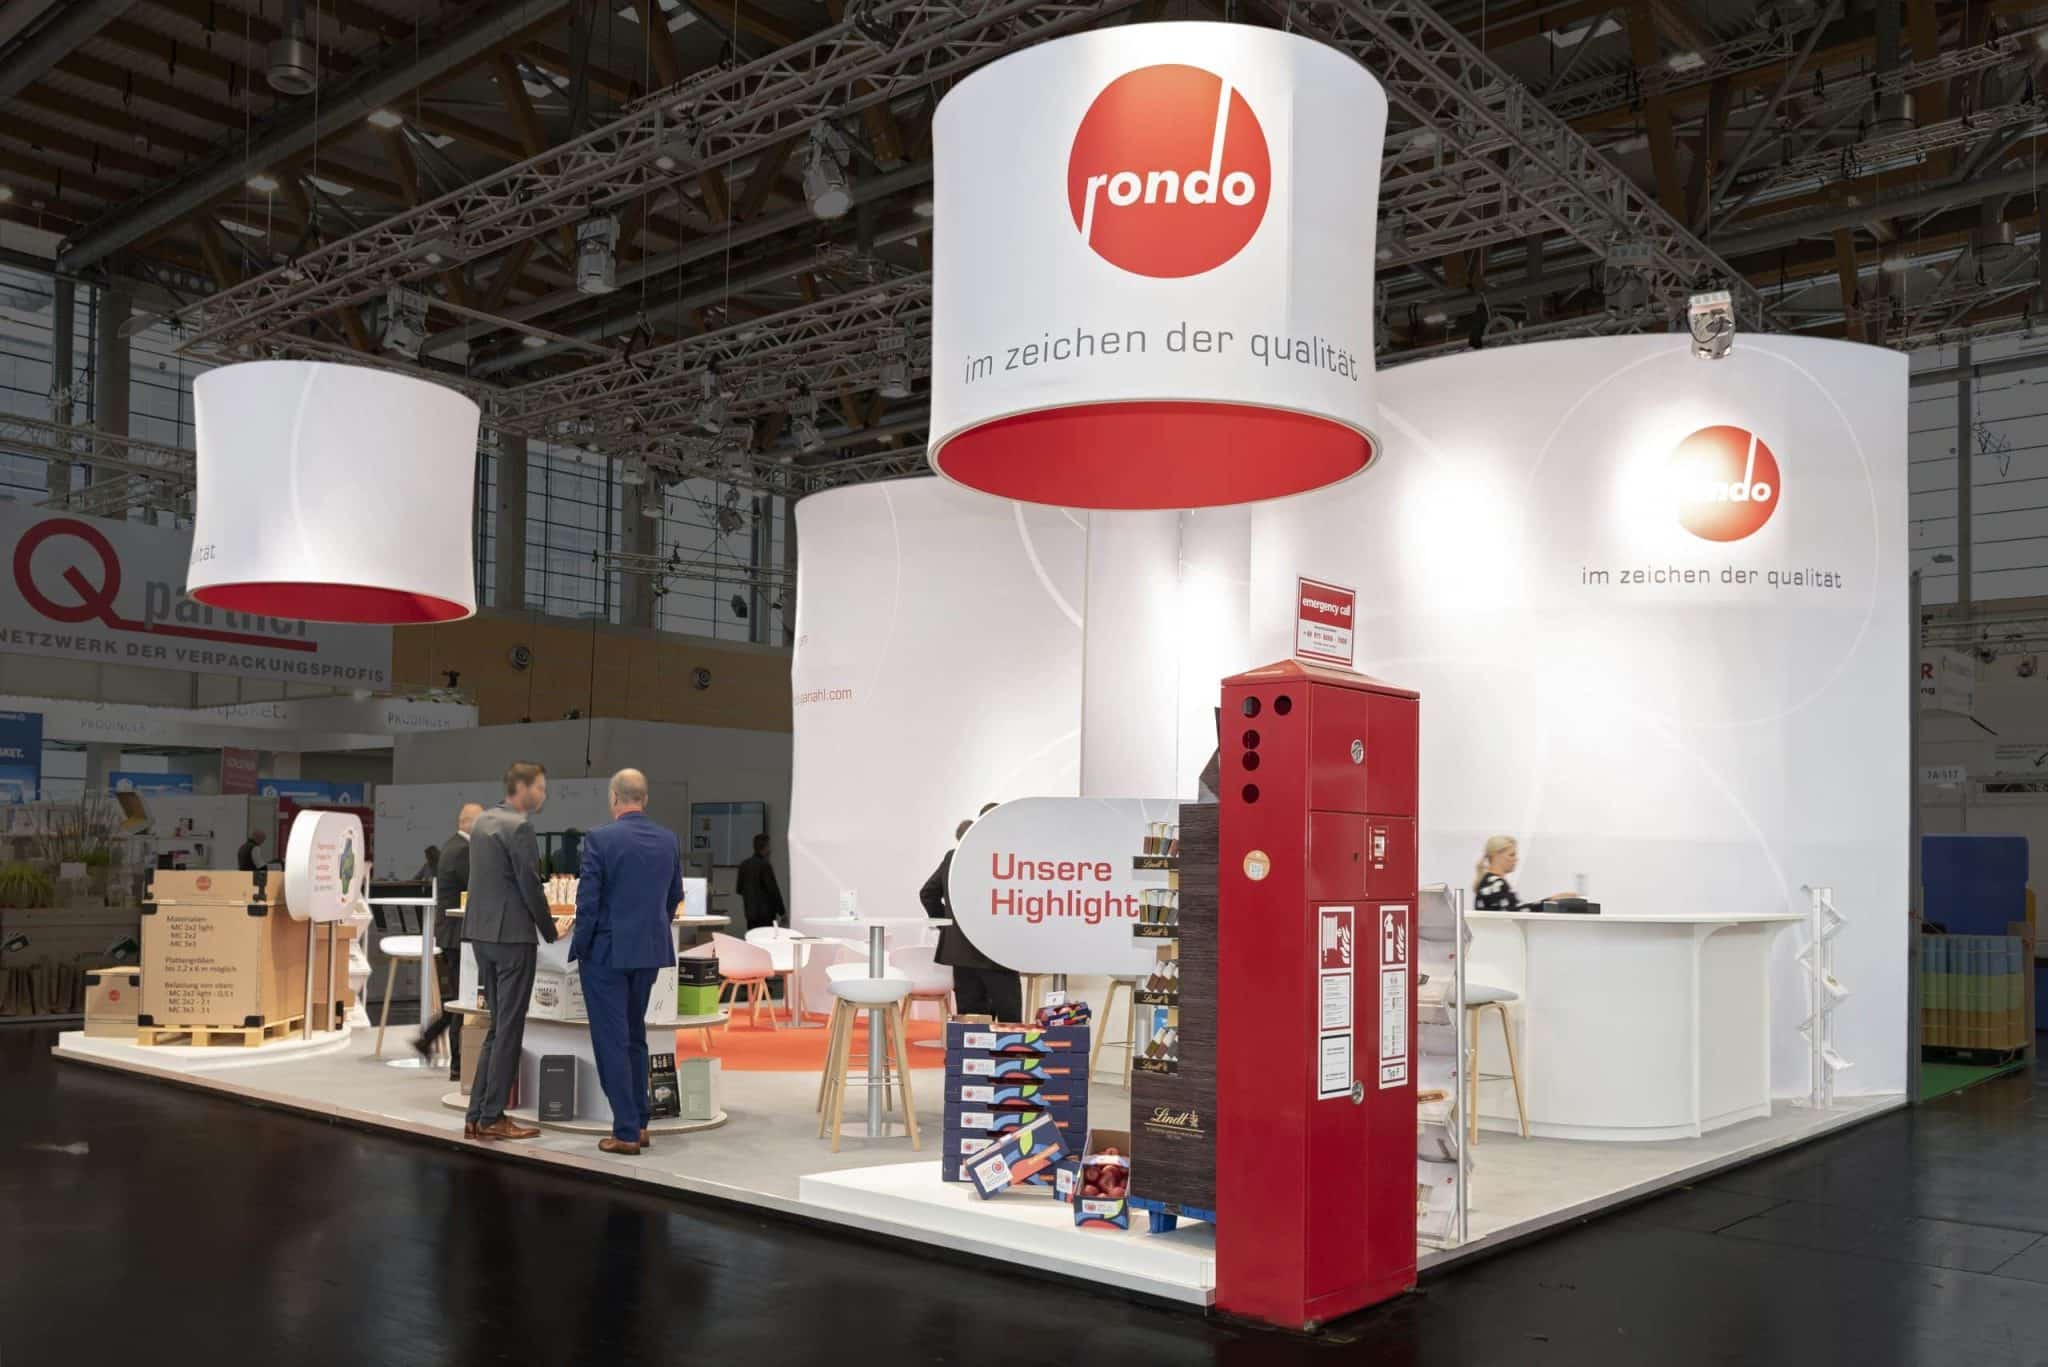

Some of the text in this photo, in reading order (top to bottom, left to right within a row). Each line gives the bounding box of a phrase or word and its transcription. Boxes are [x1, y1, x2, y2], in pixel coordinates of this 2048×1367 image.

[1081, 78, 1256, 244] rondo
[964, 321, 1359, 385] im zeichen der qualität
[1581, 566, 1609, 585] im
[1619, 565, 1711, 585] zeichen
[1720, 565, 1759, 585] der
[1302, 598, 1351, 616] emergency call
[0, 629, 384, 684] NETZWERK DER VERPACKUNGSPROFIS
[991, 852, 1112, 882] Unsere
[991, 889, 1139, 924] Highlight
[1151, 1106, 1189, 1126] Lindt
